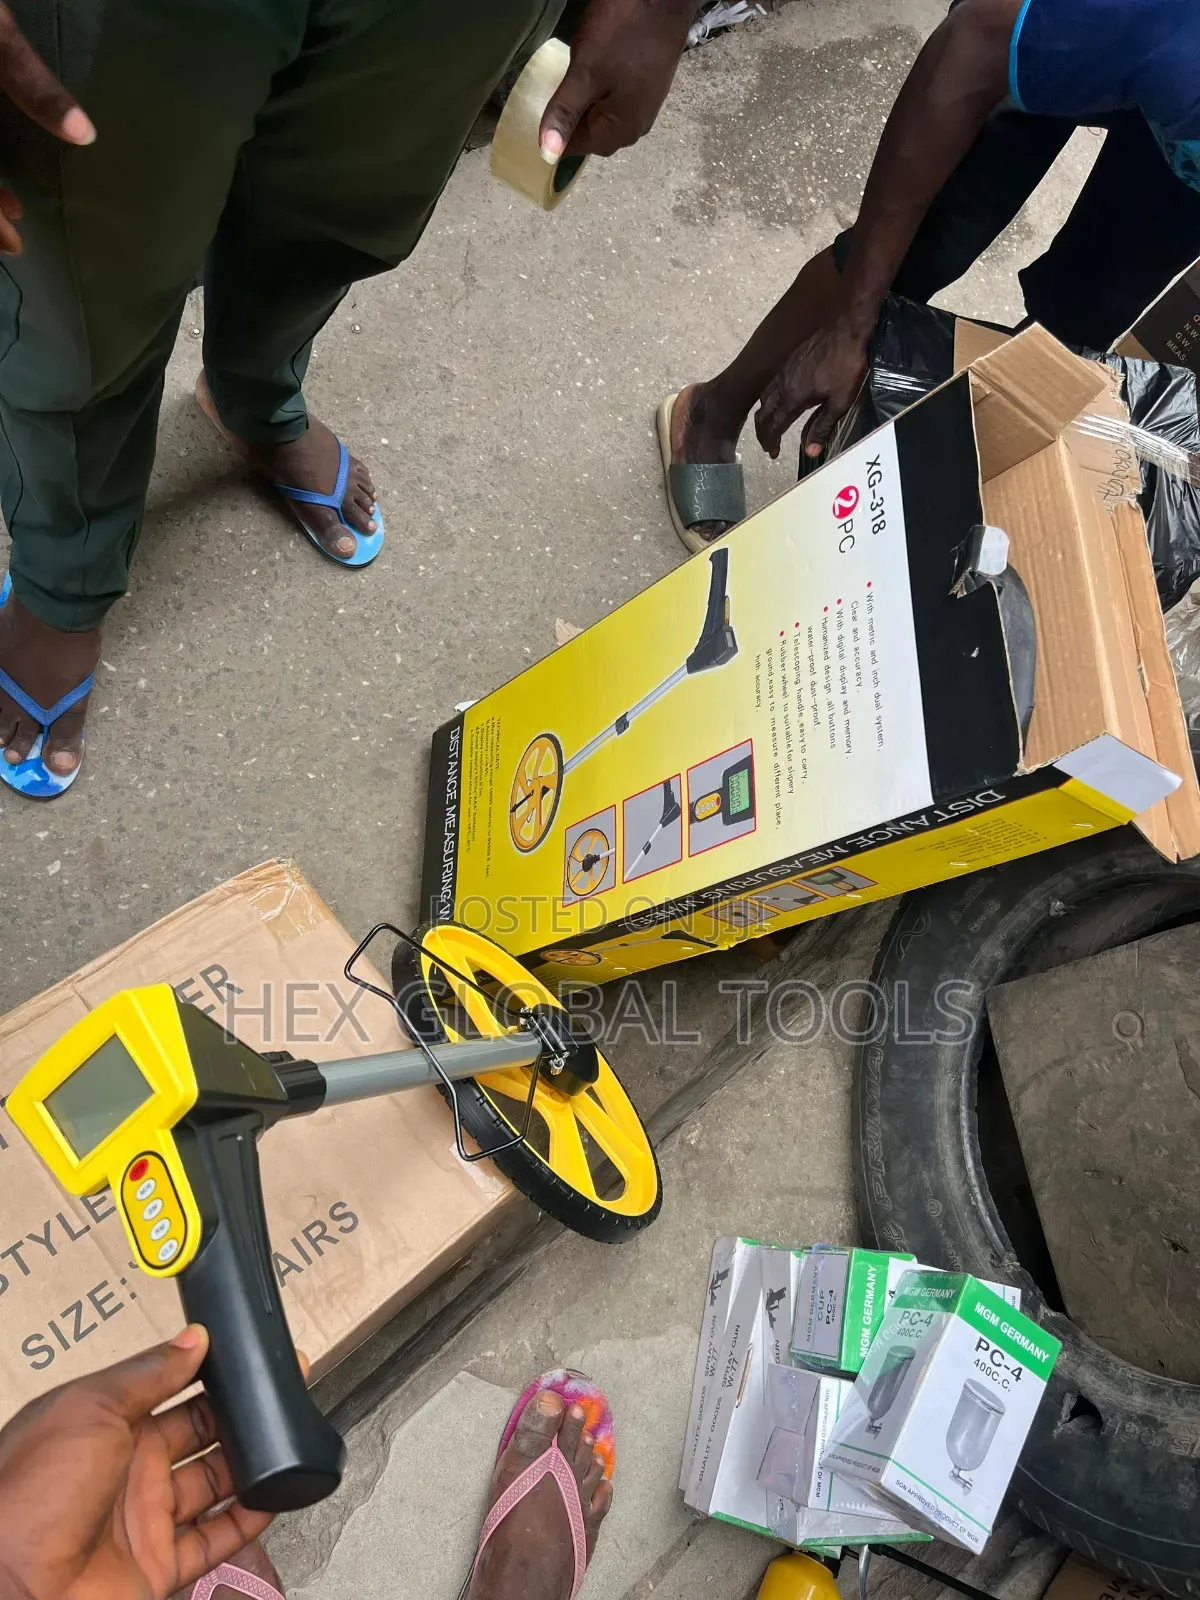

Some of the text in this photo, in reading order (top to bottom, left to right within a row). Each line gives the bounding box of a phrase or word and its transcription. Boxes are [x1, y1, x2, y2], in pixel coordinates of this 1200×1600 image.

[866, 454, 887, 535] XG-318
[836, 608, 844, 631] With
[852, 627, 860, 643] and
[822, 616, 830, 661] Humanized
[836, 634, 846, 661] digital
[793, 631, 801, 686] Telescoping
[781, 674, 790, 699] wheel
[824, 664, 832, 694] design
[839, 664, 848, 695] display
[870, 650, 878, 665] and
[874, 692, 882, 711] dual
[769, 701, 775, 712] to
[842, 700, 850, 715] and
[770, 718, 778, 757] measure
[827, 713, 836, 749] buttons
[773, 762, 781, 799] different
[440, 804, 457, 903] MEASURING
[699, 844, 849, 901] MEASURING
[21, 1201, 359, 1371] SIZE: AIRS
[806, 1265, 819, 1343] MGM GERMANY
[904, 1286, 921, 1297] MGM
[920, 1287, 956, 1299] GERMANY
[817, 1290, 825, 1322] CUP
[825, 1289, 834, 1325] PC-4
[859, 1264, 878, 1358] MGM GERMANY
[899, 1310, 934, 1328] PC-4
[974, 1301, 1050, 1363] MGM GERMANY
[705, 1340, 713, 1377] SPRAY
[722, 1324, 740, 1388] SPRAY GUN
[726, 1357, 739, 1388] W-77
[974, 1336, 1023, 1383] PC-4
[973, 1358, 1011, 1392] 400C.C.
[698, 1385, 707, 1421] GOODS
[699, 1396, 723, 1482] QUALITY GOODS
[815, 1482, 823, 1498] MGM
[895, 1479, 979, 1543] SON APPROVED PRODUCT OF MGM
